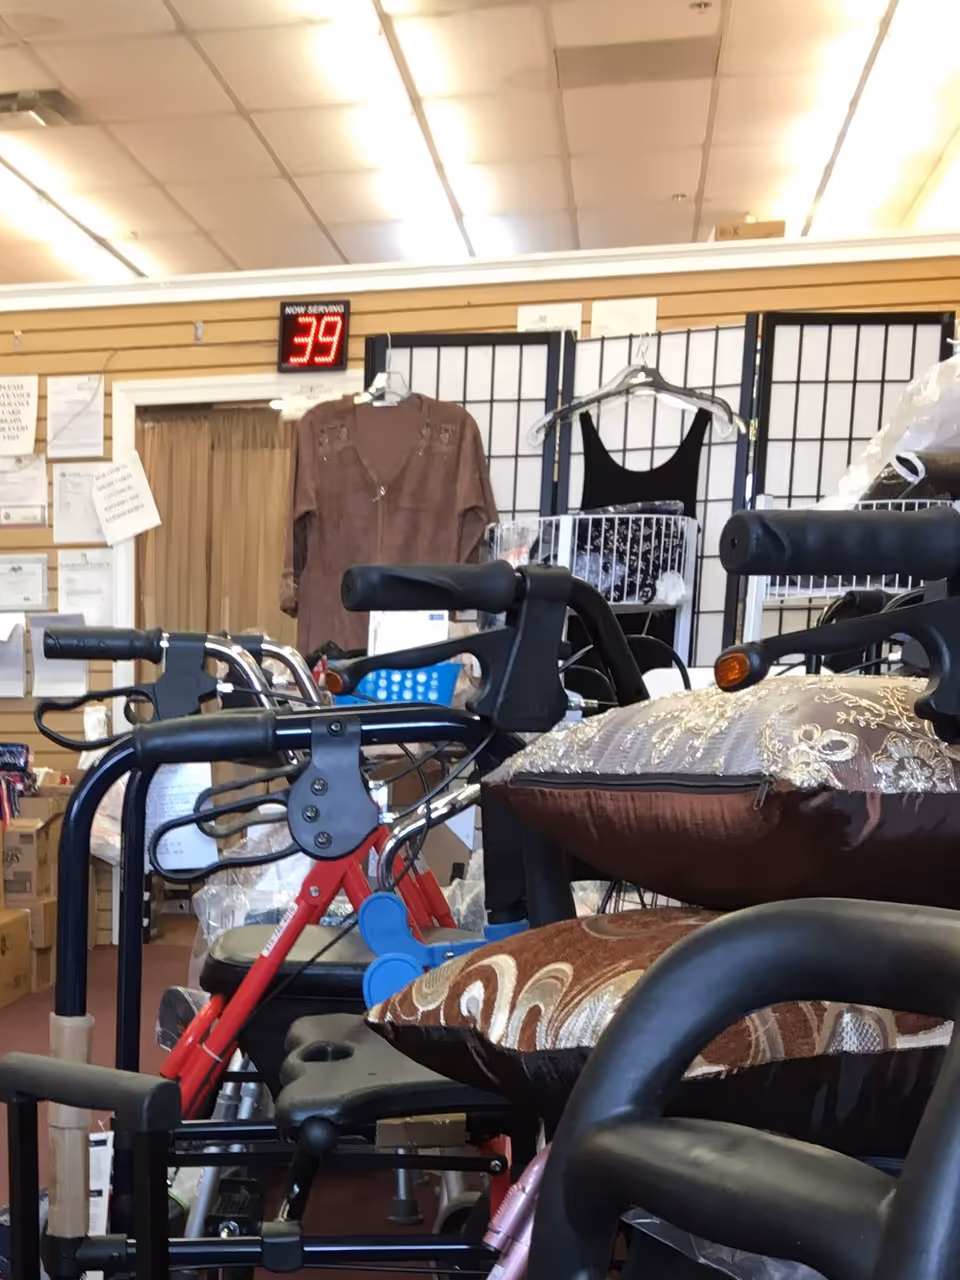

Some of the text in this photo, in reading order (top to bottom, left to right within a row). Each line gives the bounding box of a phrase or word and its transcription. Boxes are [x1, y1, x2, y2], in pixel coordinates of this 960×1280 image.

[284, 304, 344, 315] NOW SERVING
[289, 316, 343, 362] 39
